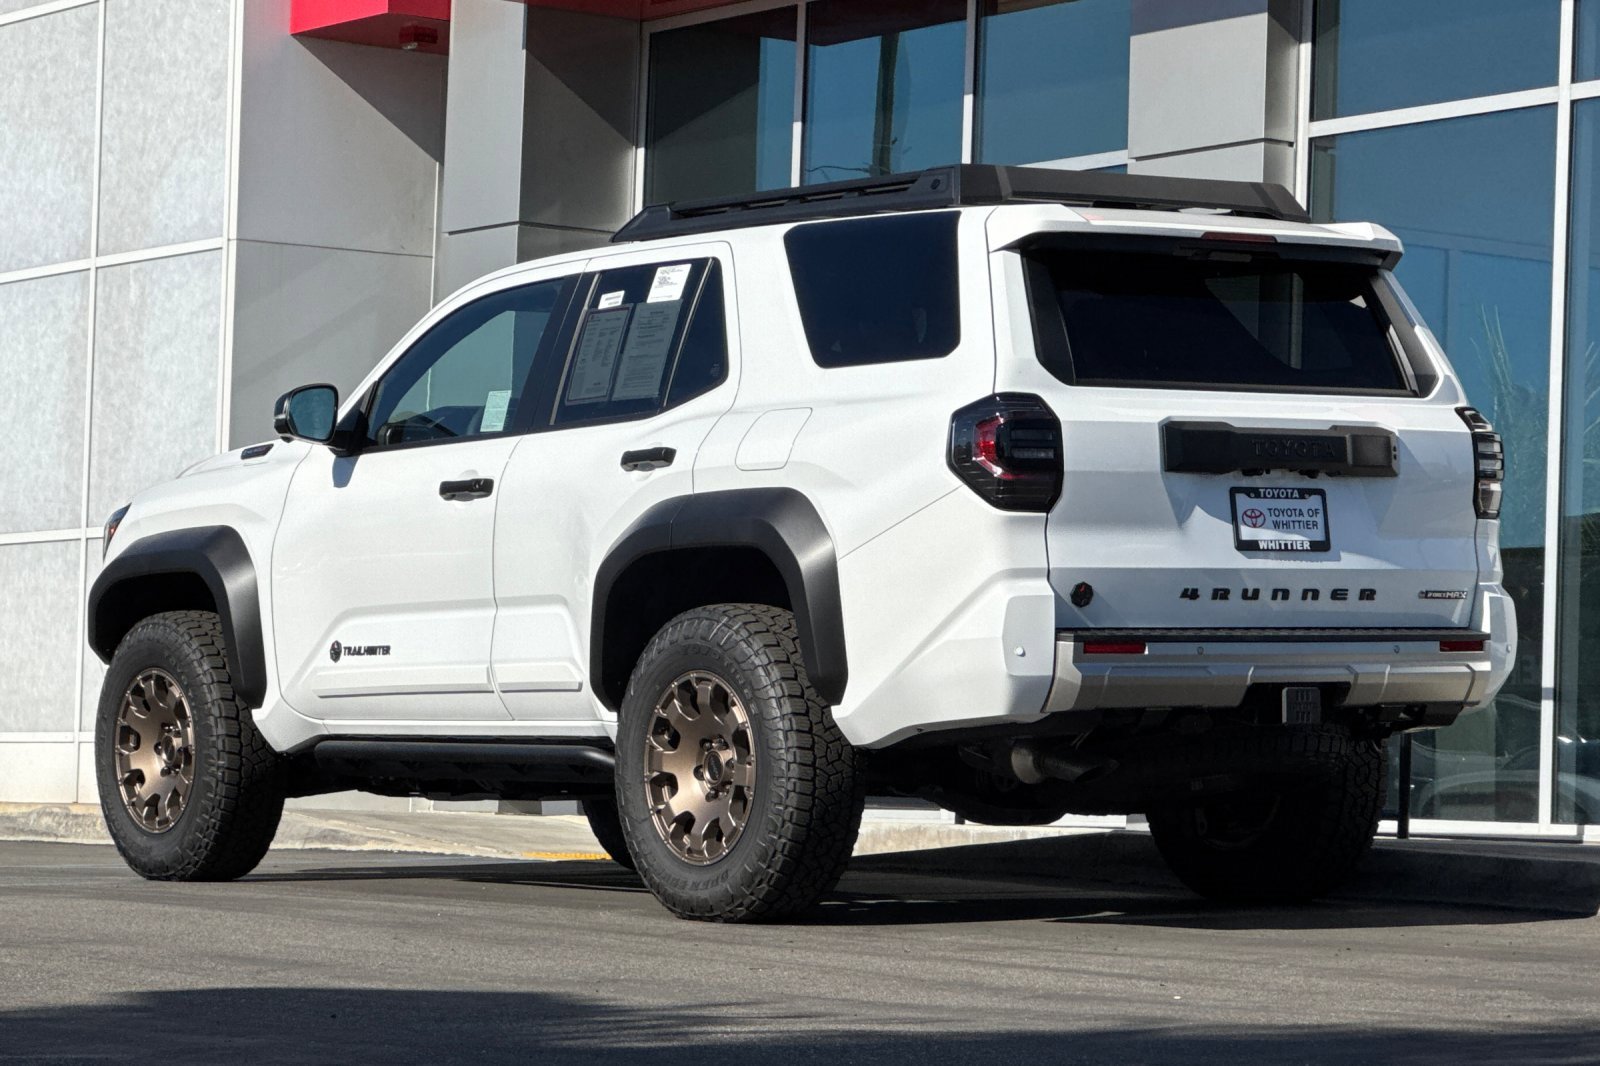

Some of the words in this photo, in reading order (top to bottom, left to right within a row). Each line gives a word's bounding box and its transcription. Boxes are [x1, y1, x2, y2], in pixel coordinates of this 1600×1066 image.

[1251, 439, 1337, 457] TOYOTA
[1259, 488, 1300, 498] TOYOTA
[1267, 508, 1305, 518] TOYOTA
[1307, 508, 1321, 518] OF
[1272, 520, 1319, 530] WHITTIER
[1258, 540, 1312, 551] WHITTIER
[1179, 587, 1377, 601] 4RUNNER
